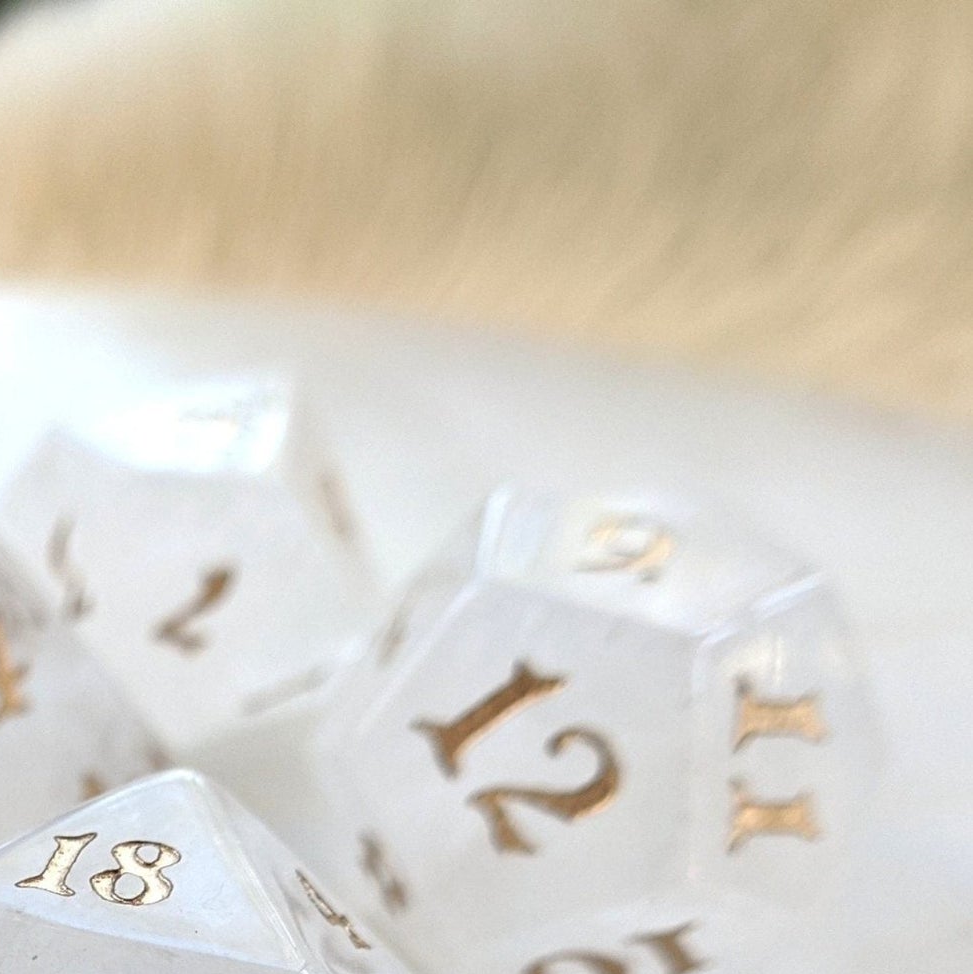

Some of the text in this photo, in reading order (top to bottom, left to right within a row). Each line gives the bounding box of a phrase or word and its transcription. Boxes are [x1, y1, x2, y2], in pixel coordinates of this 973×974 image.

[409, 658, 621, 857] 12
[726, 676, 829, 857] 11
[15, 826, 182, 906] 18
